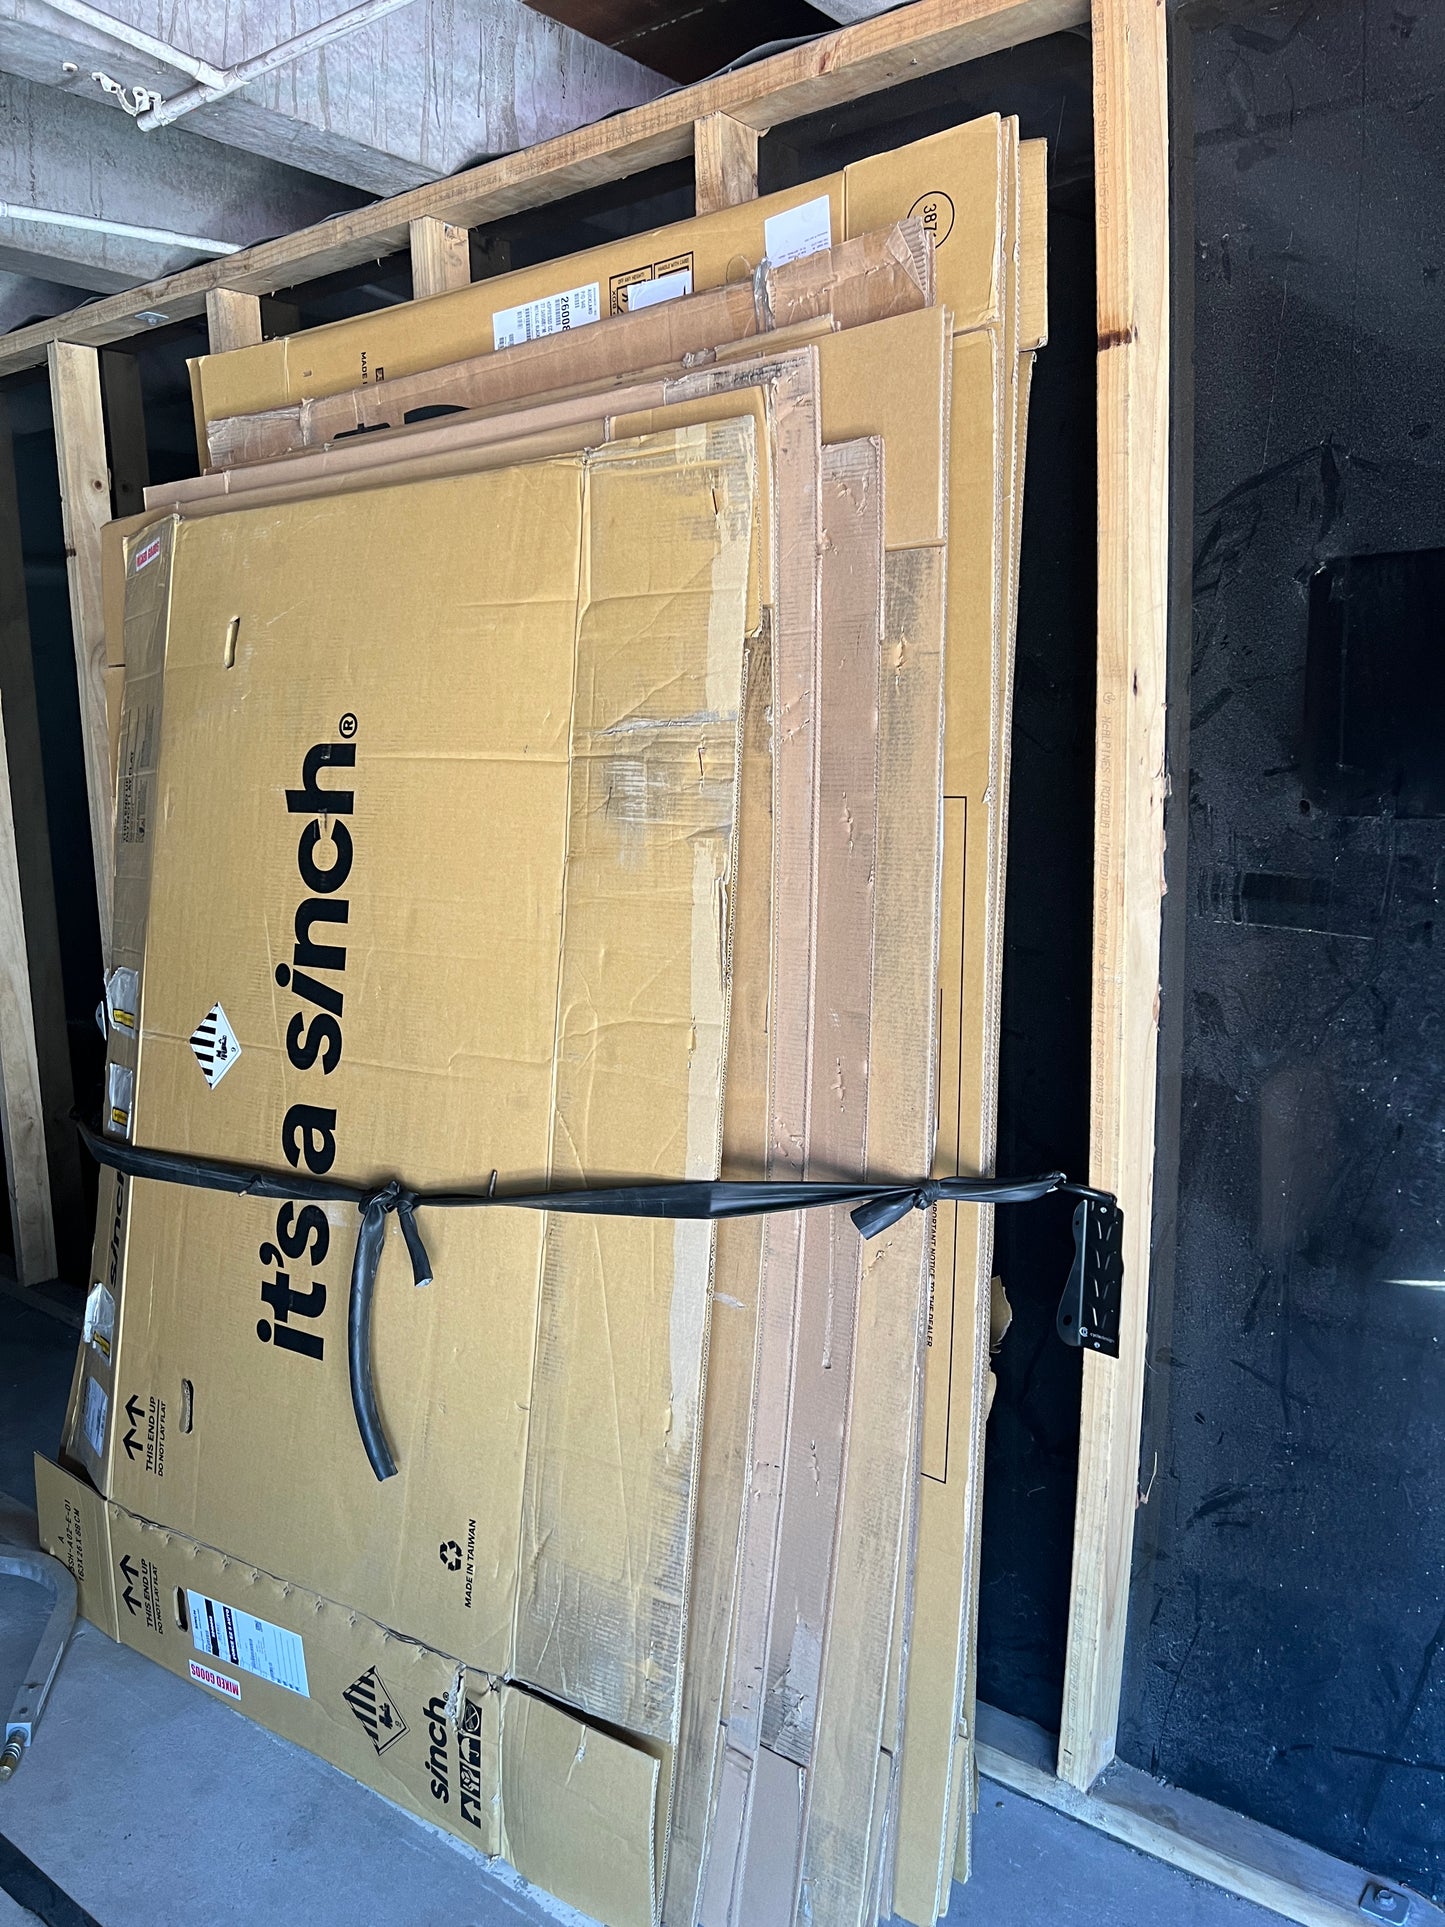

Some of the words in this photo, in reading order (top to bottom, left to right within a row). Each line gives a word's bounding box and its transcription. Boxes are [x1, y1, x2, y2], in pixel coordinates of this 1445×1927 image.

[923, 203, 937, 237] 387
[1101, 716, 1112, 774] McALPINES
[281, 1103, 338, 1176] a
[1094, 1108, 1104, 1169] 31-05-2021
[256, 1199, 331, 1362] it's
[149, 1396, 156, 1413] UP
[146, 1444, 154, 1472] THIS
[158, 1464, 164, 1477] DO
[58, 1536, 64, 1544] A
[467, 1519, 476, 1562] TAIWAN
[141, 1558, 148, 1574] UP
[466, 1563, 474, 1576] IN
[142, 1575, 150, 1602] END
[464, 1576, 474, 1608] MADE
[144, 1602, 153, 1628] THIS
[158, 1622, 164, 1634] DO
[190, 1663, 215, 1684] GOODS
[216, 1676, 239, 1696] MIXED
